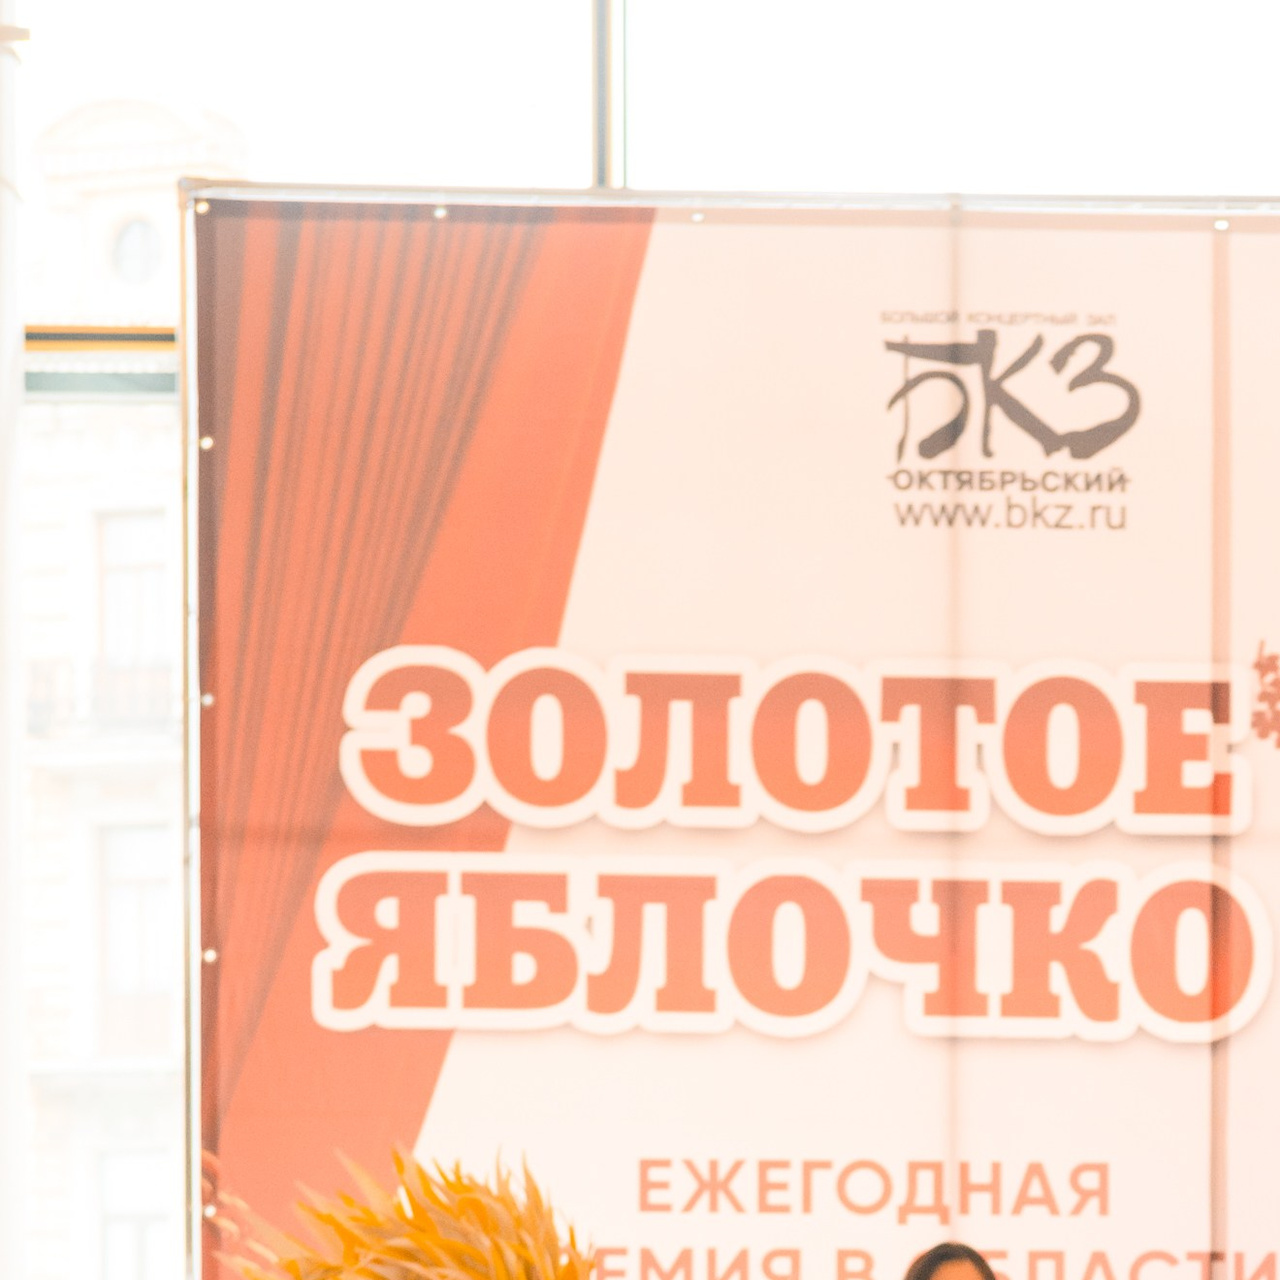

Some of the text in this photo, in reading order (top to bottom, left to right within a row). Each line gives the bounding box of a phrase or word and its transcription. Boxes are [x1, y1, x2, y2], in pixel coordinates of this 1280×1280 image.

[884, 329, 1141, 462] БКЗ
[887, 468, 1131, 493] ОКТЯБРЬСКИЙ
[894, 496, 1128, 530] www.bkz.ru
[358, 666, 1233, 818] ЗОЛОТОЕ
[330, 870, 1256, 1020] ЯБЛОЧКО
[638, 1158, 1110, 1225] ЕЖЕГОДНАЯ
